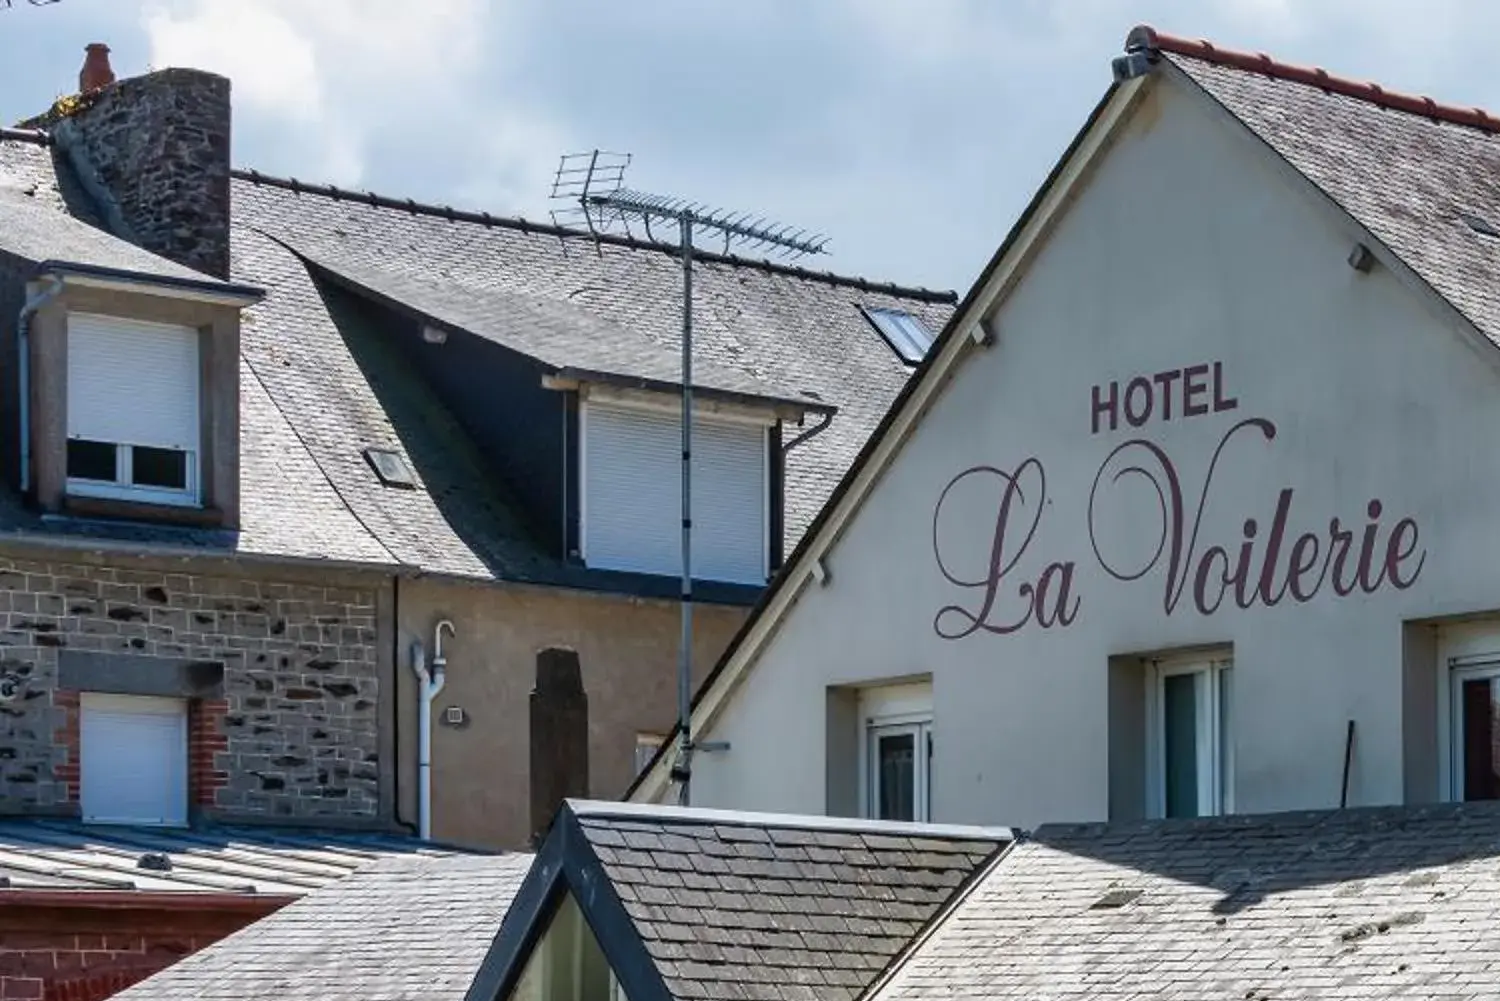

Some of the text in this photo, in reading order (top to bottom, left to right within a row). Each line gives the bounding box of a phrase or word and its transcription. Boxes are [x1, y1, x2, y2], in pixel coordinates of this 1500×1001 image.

[1091, 361, 1238, 434] HOTEL
[934, 418, 1426, 639] La Voilerie
